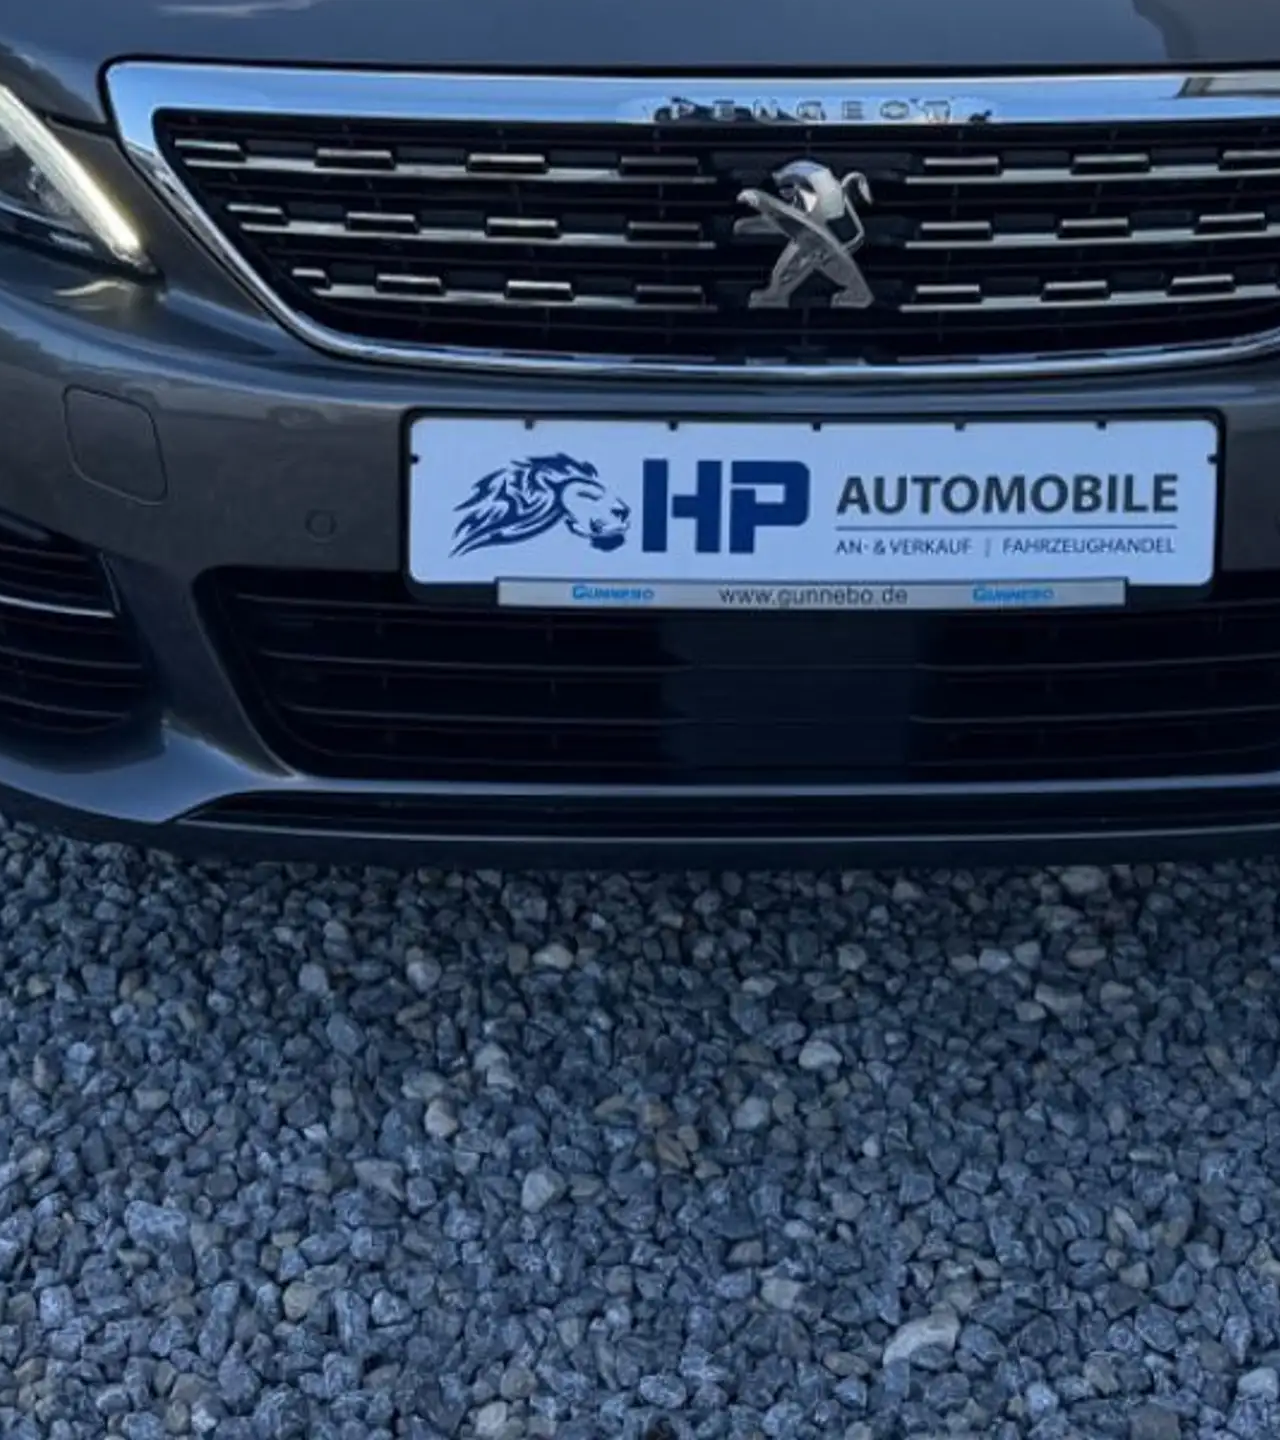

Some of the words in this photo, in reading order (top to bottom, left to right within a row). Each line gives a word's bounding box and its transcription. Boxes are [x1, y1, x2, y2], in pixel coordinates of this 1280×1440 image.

[642, 459, 810, 554] HP
[835, 474, 1179, 515] AUTOMOBILE
[873, 538, 886, 556] &
[889, 537, 973, 556] VERKAUF
[1002, 536, 1176, 555] FAHRZEUGHANDEL
[719, 585, 908, 608] www.gunnebo.de
